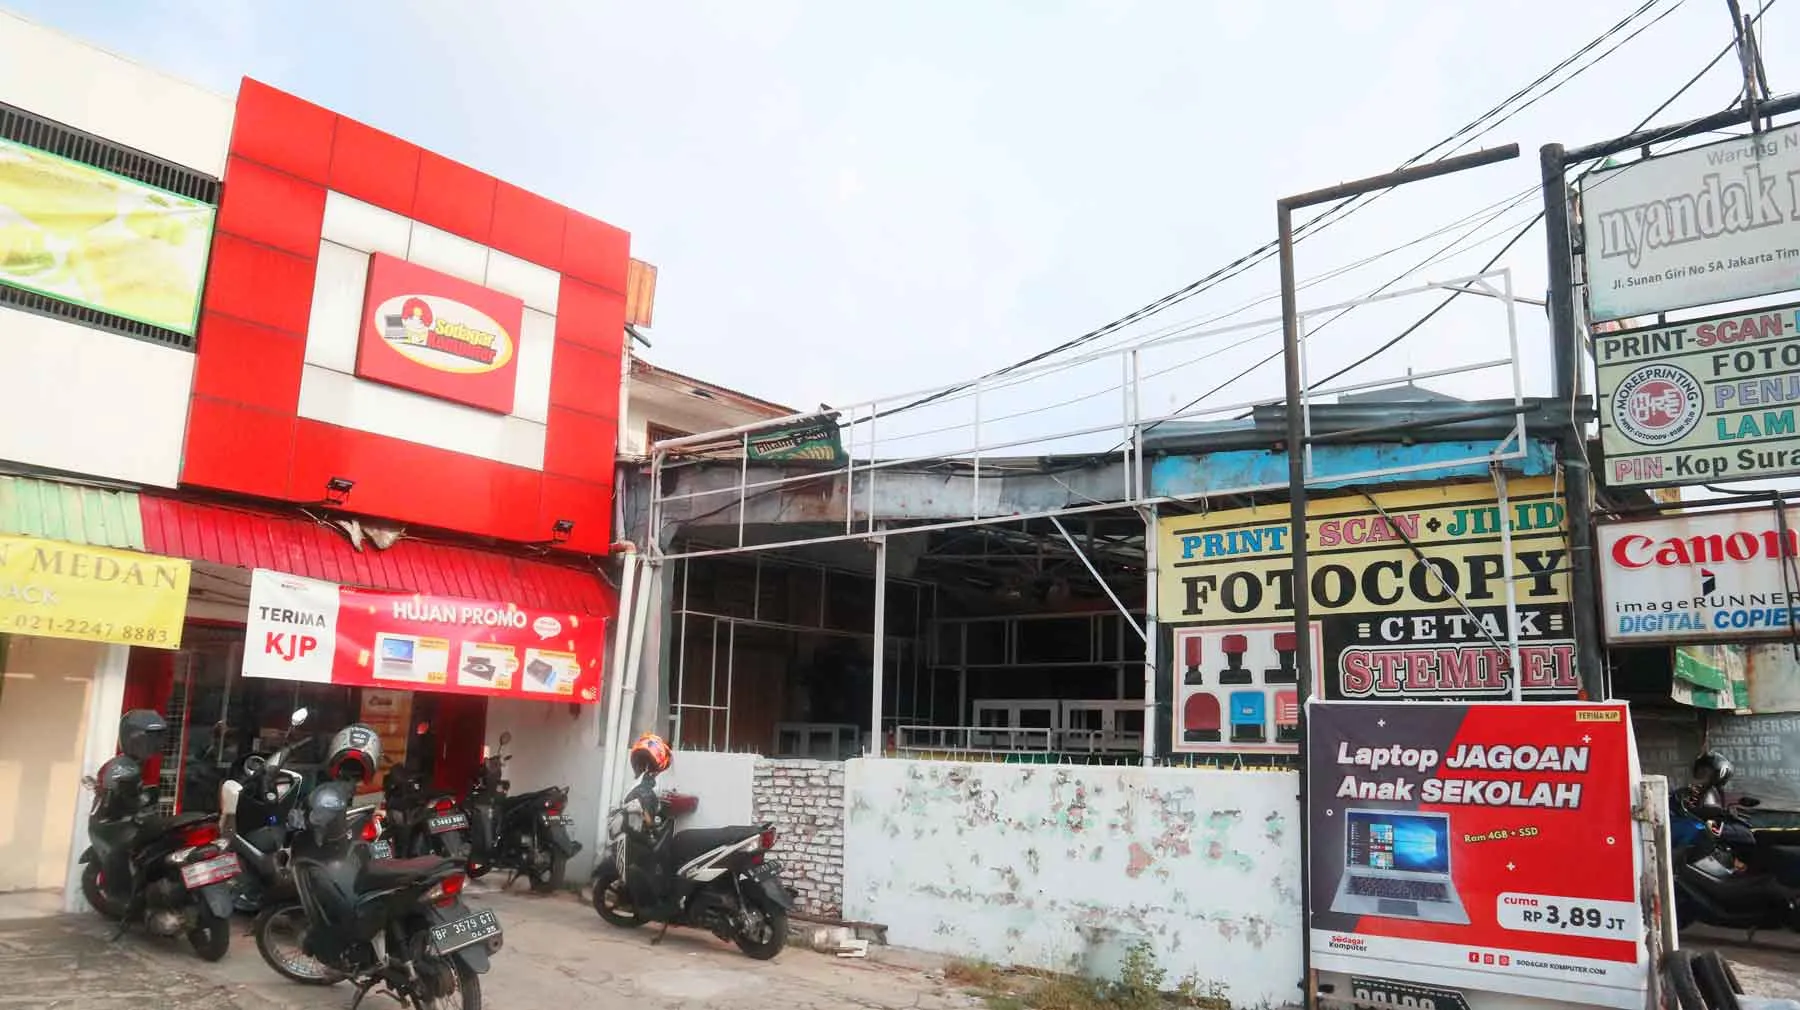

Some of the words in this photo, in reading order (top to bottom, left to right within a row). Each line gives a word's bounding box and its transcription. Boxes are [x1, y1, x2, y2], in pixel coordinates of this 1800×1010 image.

[1707, 138, 1778, 166] Warung
[1599, 163, 1783, 269] nyandak
[1627, 273, 1662, 287] Sunan
[1665, 267, 1686, 280] Giri
[1689, 265, 1705, 277] No
[1726, 251, 1773, 270] Jakarta
[1712, 343, 1800, 376] FOTO
[1616, 367, 1699, 410] MOREEPRINTING
[1717, 409, 1795, 441] LAM
[1737, 449, 1800, 471] Sura
[1181, 527, 1287, 558] PRINT
[1319, 513, 1419, 547] SCAN
[1446, 501, 1565, 537] JILID
[1611, 528, 1798, 568] Canon
[30, 547, 178, 591] MEDAN
[1181, 549, 1567, 616] FOTOCOPY
[0, 582, 58, 606] ACK
[15, 614, 114, 638] 021-2247
[122, 625, 168, 643] 8883
[259, 606, 326, 629] TERIMA
[392, 601, 457, 624] HUJAN
[462, 607, 528, 628] PROMO
[1380, 611, 1542, 642] CETAK
[1619, 612, 1706, 634] DIGITAL
[265, 631, 318, 661] KJP
[1342, 646, 1577, 693] STEMPEL
[1337, 741, 1438, 772] Laptop
[1446, 745, 1589, 772] JAGOAN
[1336, 775, 1414, 801] Anak
[1421, 779, 1581, 808] SEKOLAH
[1464, 833, 1487, 843] Ram
[1488, 829, 1508, 840] 4GB
[1519, 827, 1538, 837] SSD
[1504, 896, 1539, 907] cuma
[453, 919, 477, 934] 3579
[1523, 910, 1542, 922] RP
[1546, 905, 1602, 929] 3,89
[1606, 918, 1626, 931] JT
[1329, 941, 1368, 952] Komputer
